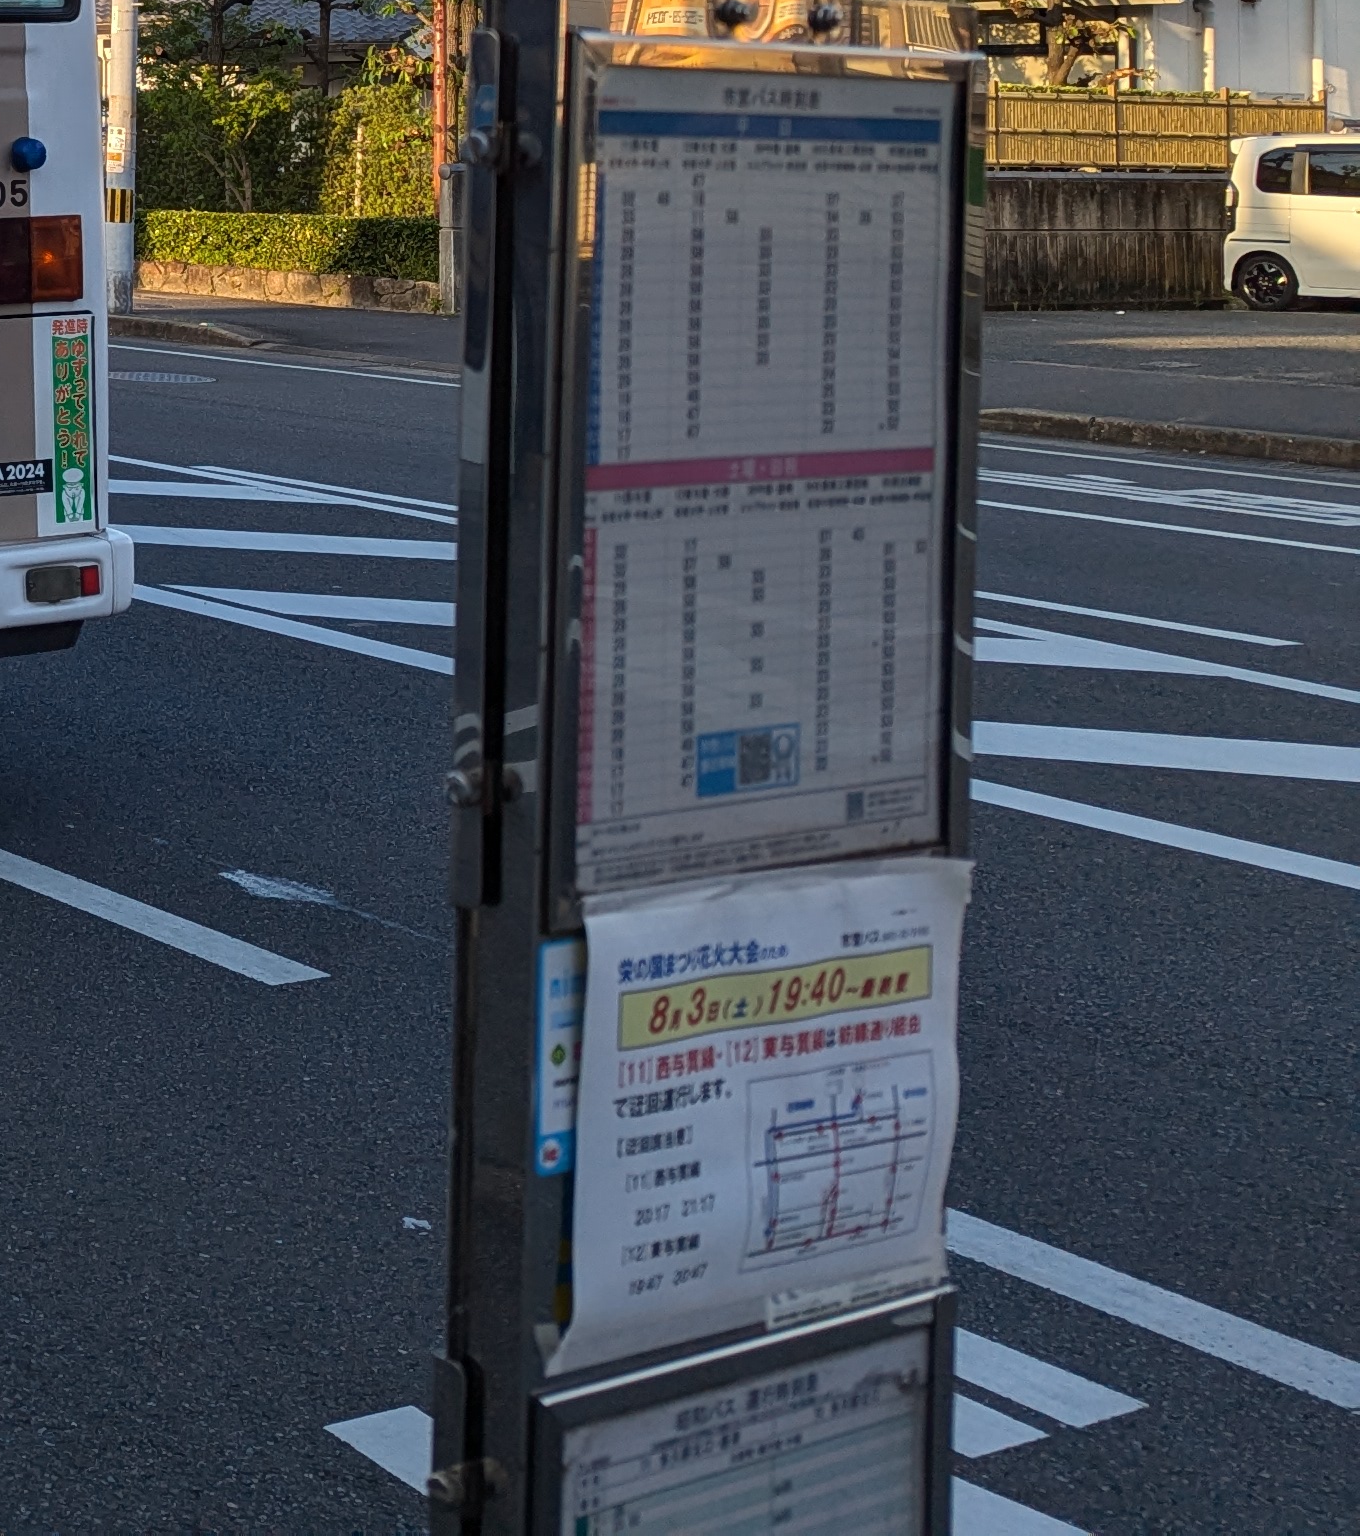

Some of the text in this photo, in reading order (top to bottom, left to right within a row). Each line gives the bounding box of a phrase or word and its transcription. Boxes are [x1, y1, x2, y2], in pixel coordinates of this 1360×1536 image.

[52, 318, 89, 336] 発進時
[70, 339, 88, 468] ゆずってくれて
[6, 463, 45, 480] 2024
